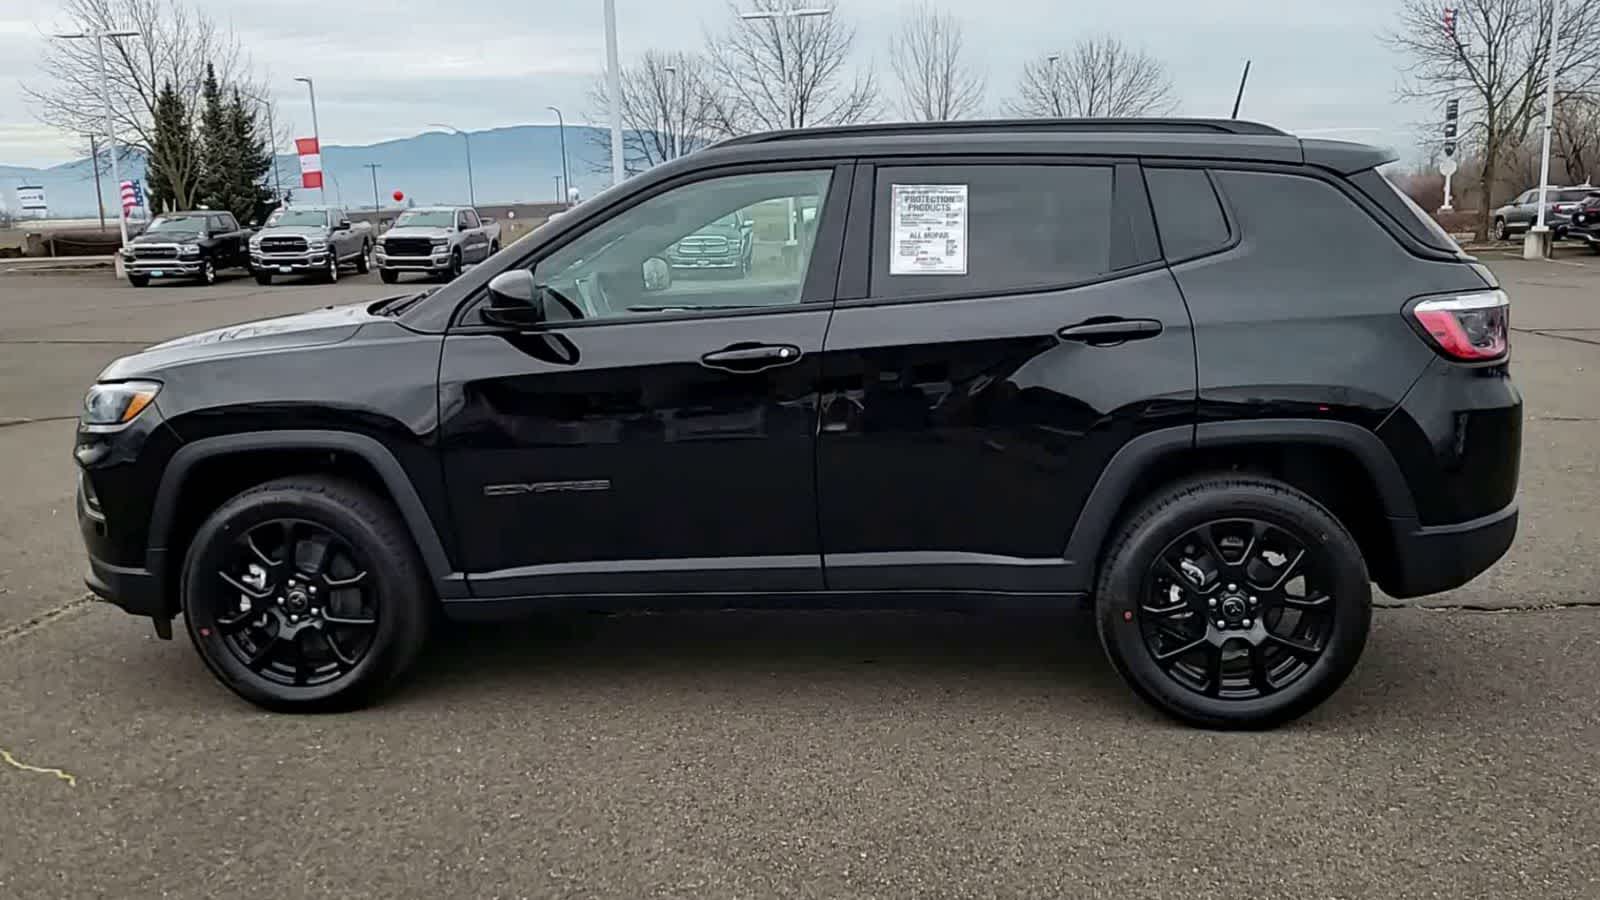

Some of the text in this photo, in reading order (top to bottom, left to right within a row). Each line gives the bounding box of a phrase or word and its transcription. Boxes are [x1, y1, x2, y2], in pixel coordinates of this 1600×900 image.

[904, 195, 955, 203] PROTECTION
[907, 203, 952, 212] PRODUCTS
[909, 231, 922, 240] ALL
